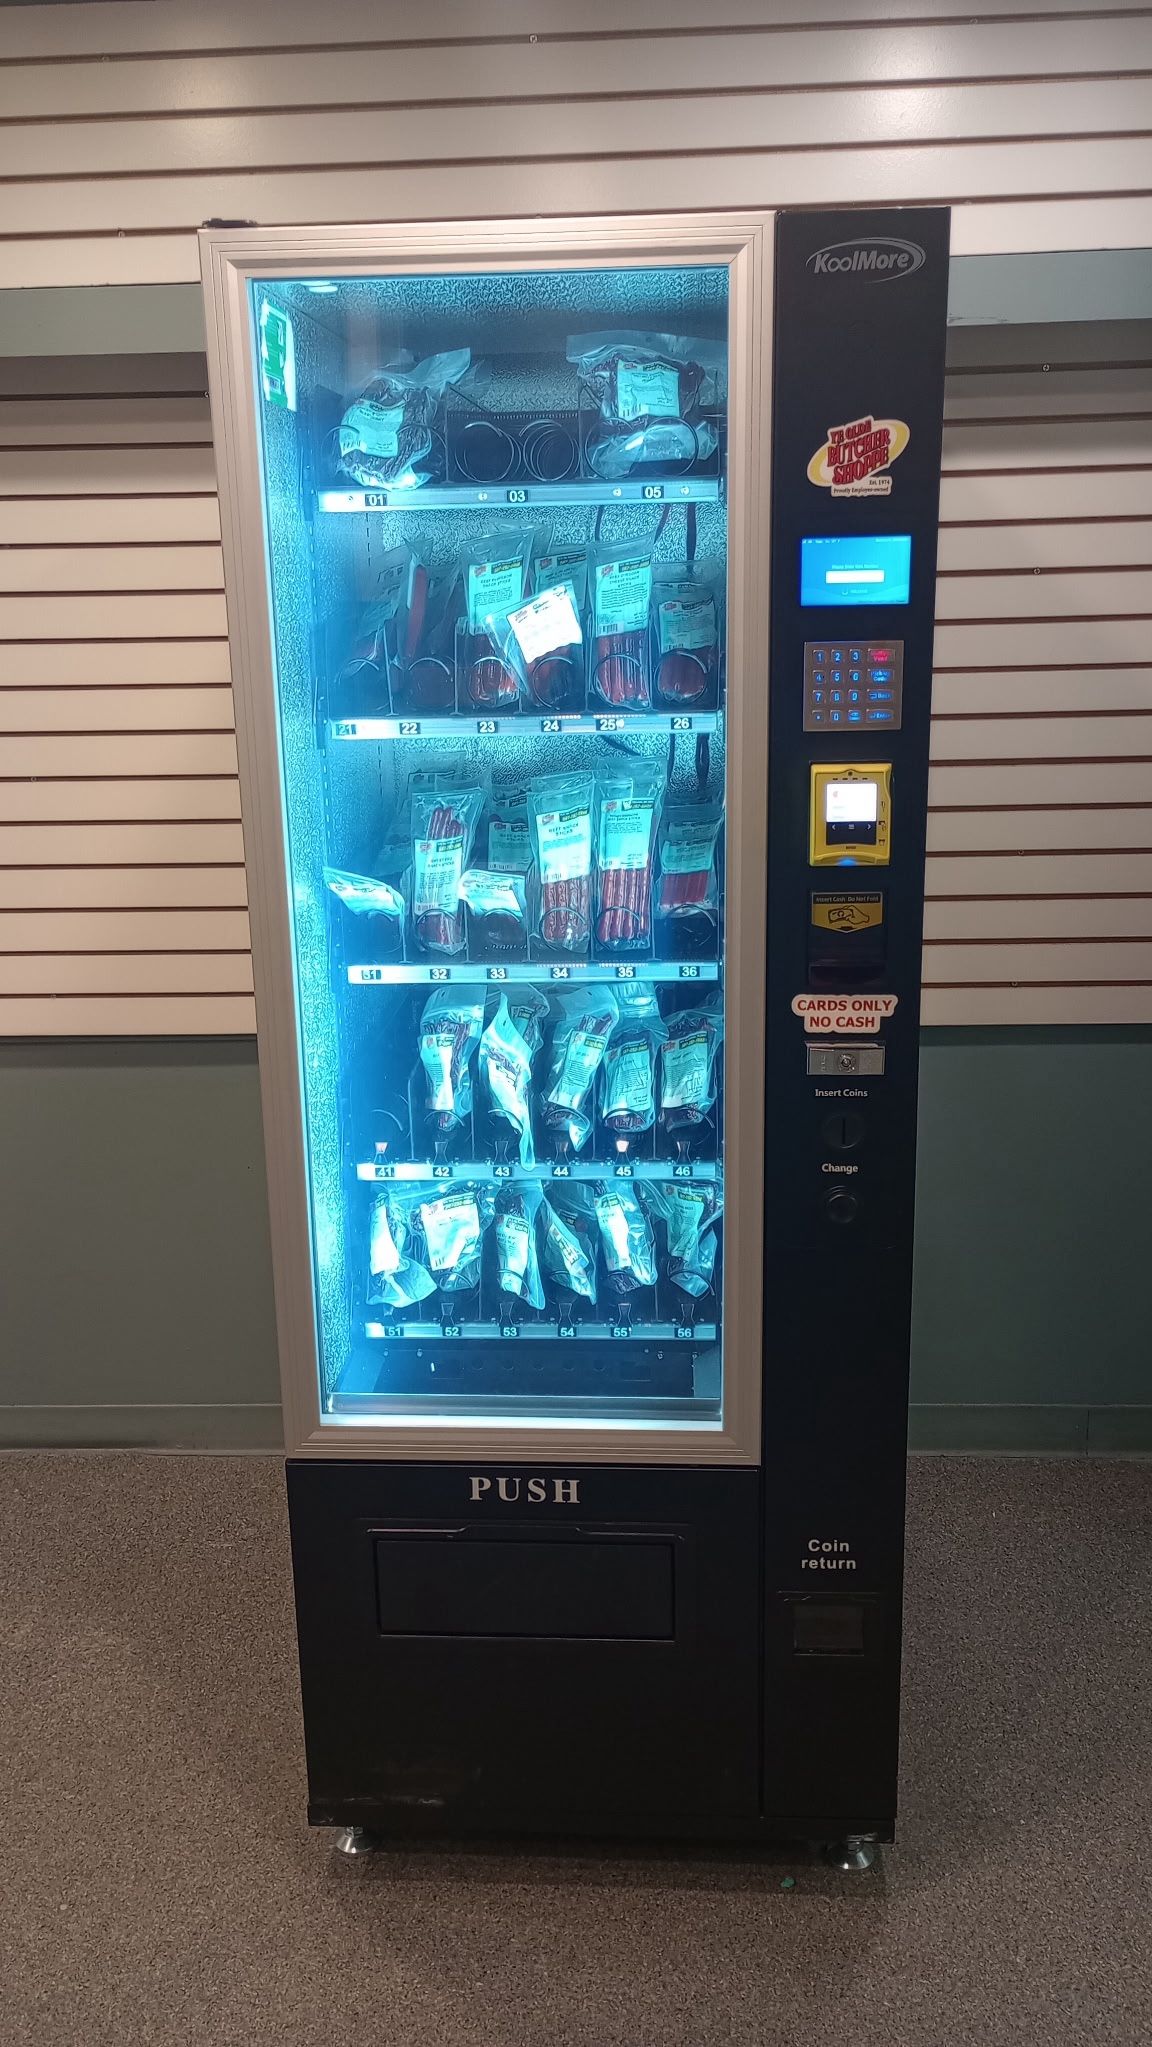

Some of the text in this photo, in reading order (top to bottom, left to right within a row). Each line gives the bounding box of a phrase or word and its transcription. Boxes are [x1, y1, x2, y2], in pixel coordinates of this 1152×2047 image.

[814, 250, 910, 274] KoolMore
[830, 420, 872, 444] YE OLDE
[827, 428, 891, 467] BUTCHER
[832, 446, 889, 485] SHOPPE
[508, 490, 526, 503] 03
[644, 486, 662, 499] 05
[368, 494, 385, 507] 01
[401, 723, 418, 735] 22
[479, 721, 496, 733] 23
[543, 720, 560, 732] 24
[599, 719, 617, 731] 25
[673, 717, 690, 730] 26
[338, 724, 352, 736] 21
[431, 969, 448, 980] 32
[490, 968, 506, 979] 33
[552, 967, 569, 979] 34
[617, 966, 634, 978] 35
[681, 966, 698, 977] 36
[797, 1000, 893, 1011] CARDS ONLY
[809, 1016, 875, 1028] NO CASH
[815, 1088, 868, 1097] Insert Coins
[377, 1166, 392, 1177] 41
[434, 1166, 450, 1177] 42
[494, 1166, 511, 1177] 43
[553, 1166, 569, 1177] 44
[615, 1166, 632, 1176] 45
[675, 1166, 691, 1176] 46
[821, 1163, 859, 1175] Change
[388, 1327, 401, 1337] 51
[444, 1326, 460, 1337] 52
[502, 1326, 518, 1337] 53
[559, 1327, 575, 1337] 54
[613, 1327, 628, 1338] 55
[677, 1327, 692, 1338] 56
[469, 1476, 580, 1504] PUSH
[808, 1539, 850, 1552] Coin
[801, 1557, 856, 1569] return
